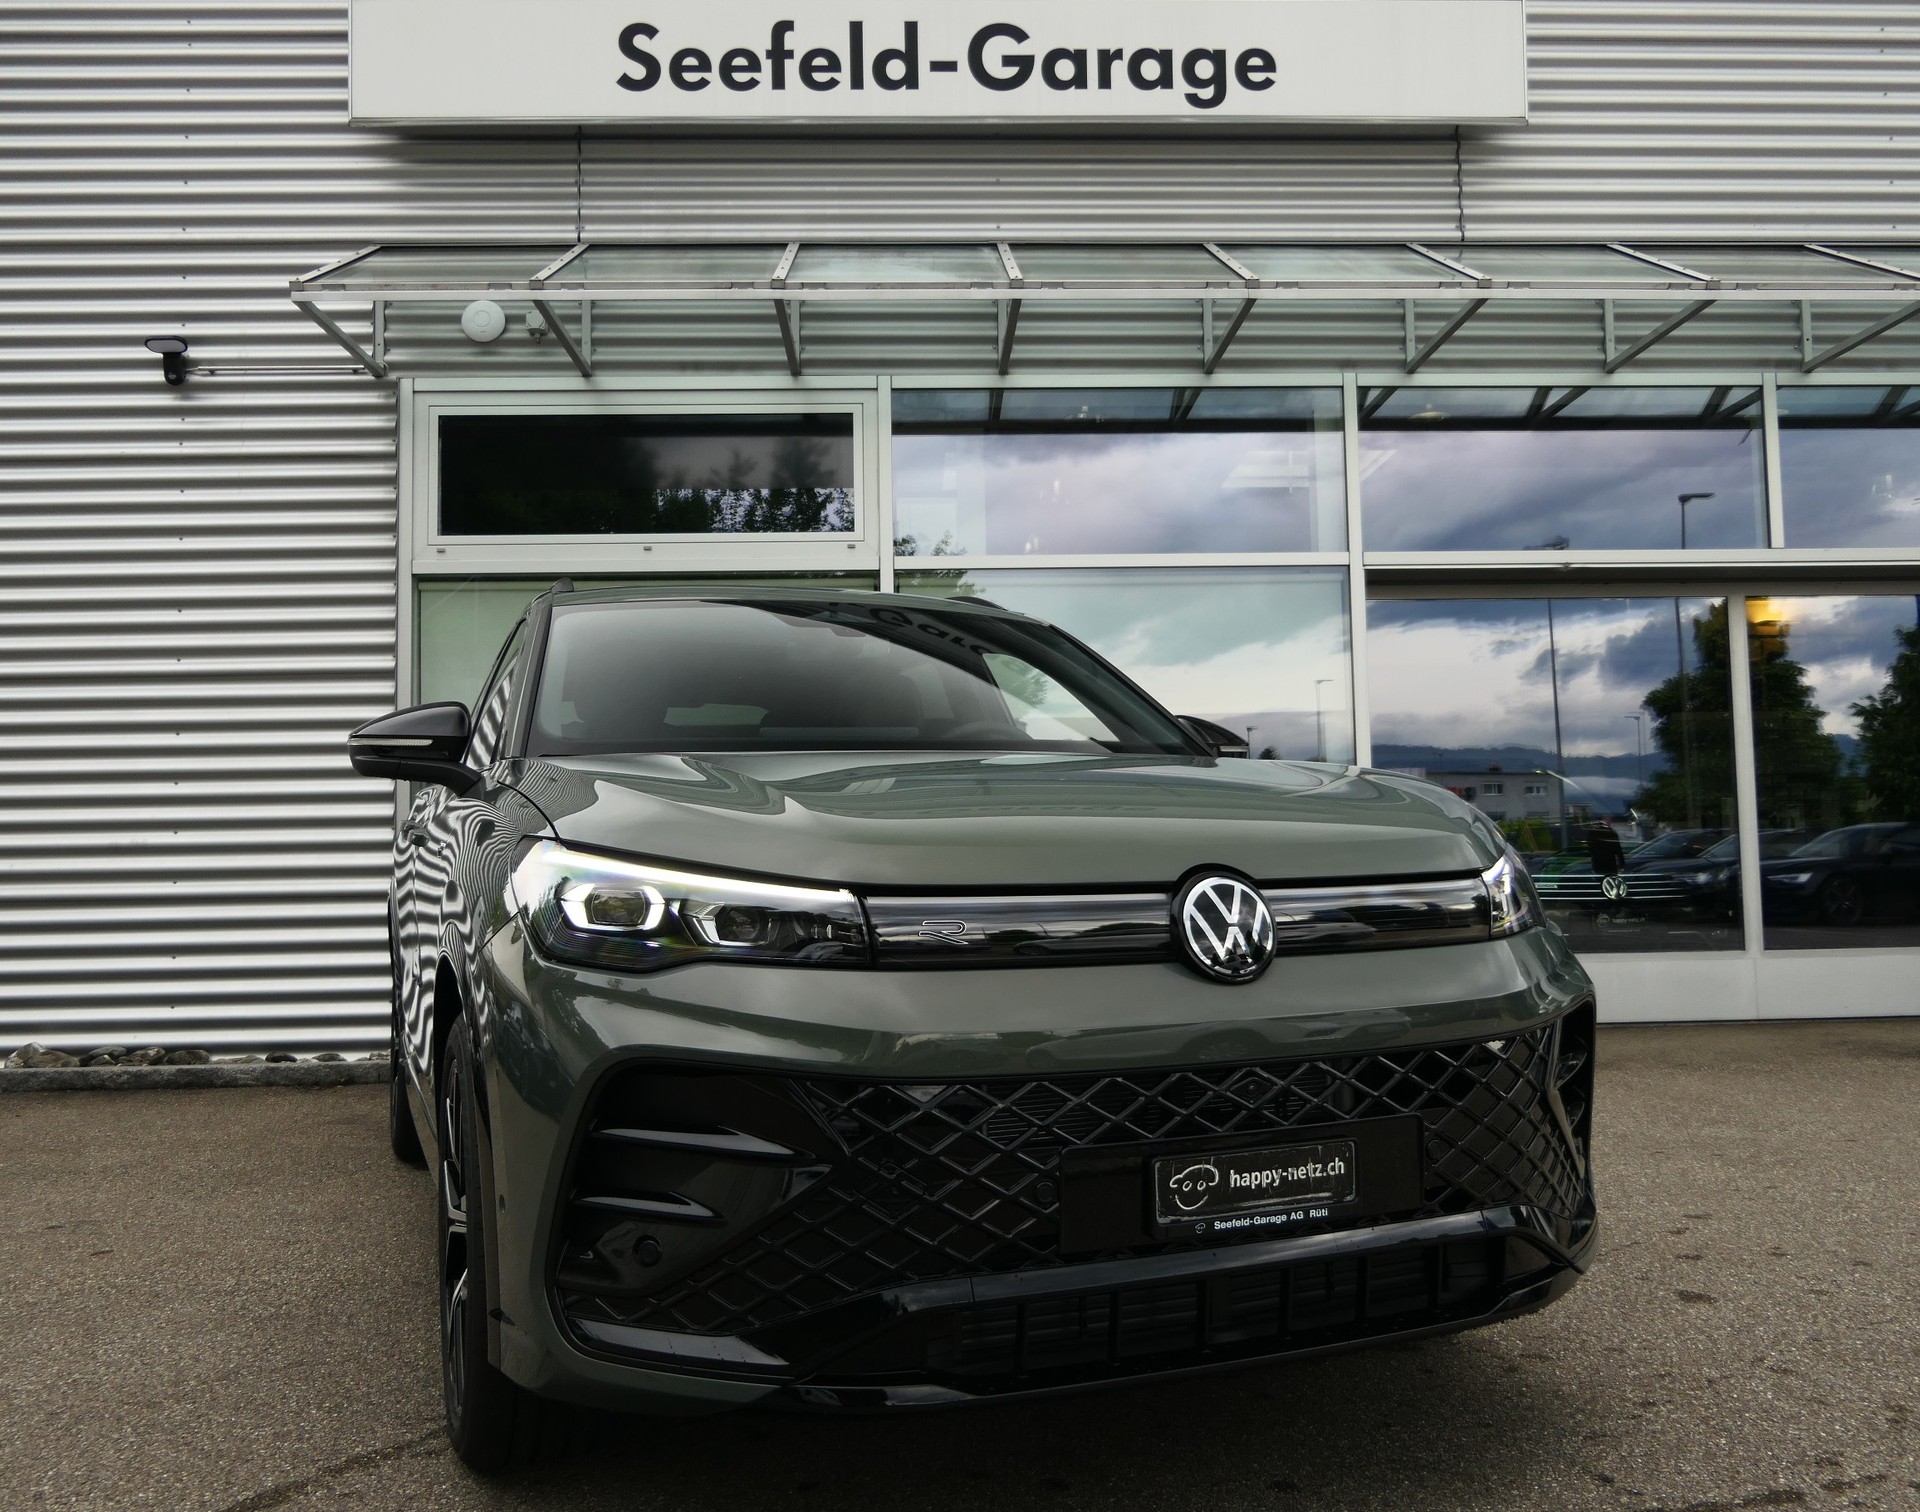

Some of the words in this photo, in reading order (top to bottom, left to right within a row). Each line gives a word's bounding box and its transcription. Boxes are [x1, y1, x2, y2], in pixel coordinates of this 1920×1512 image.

[616, 20, 1277, 109] Seefeld-Garage
[1229, 1157, 1345, 1189] happy-netz.ch
[1214, 1214, 1287, 1230] Seefeld-Garage
[1290, 1210, 1304, 1220] AG
[1309, 1207, 1328, 1218] Rüti
